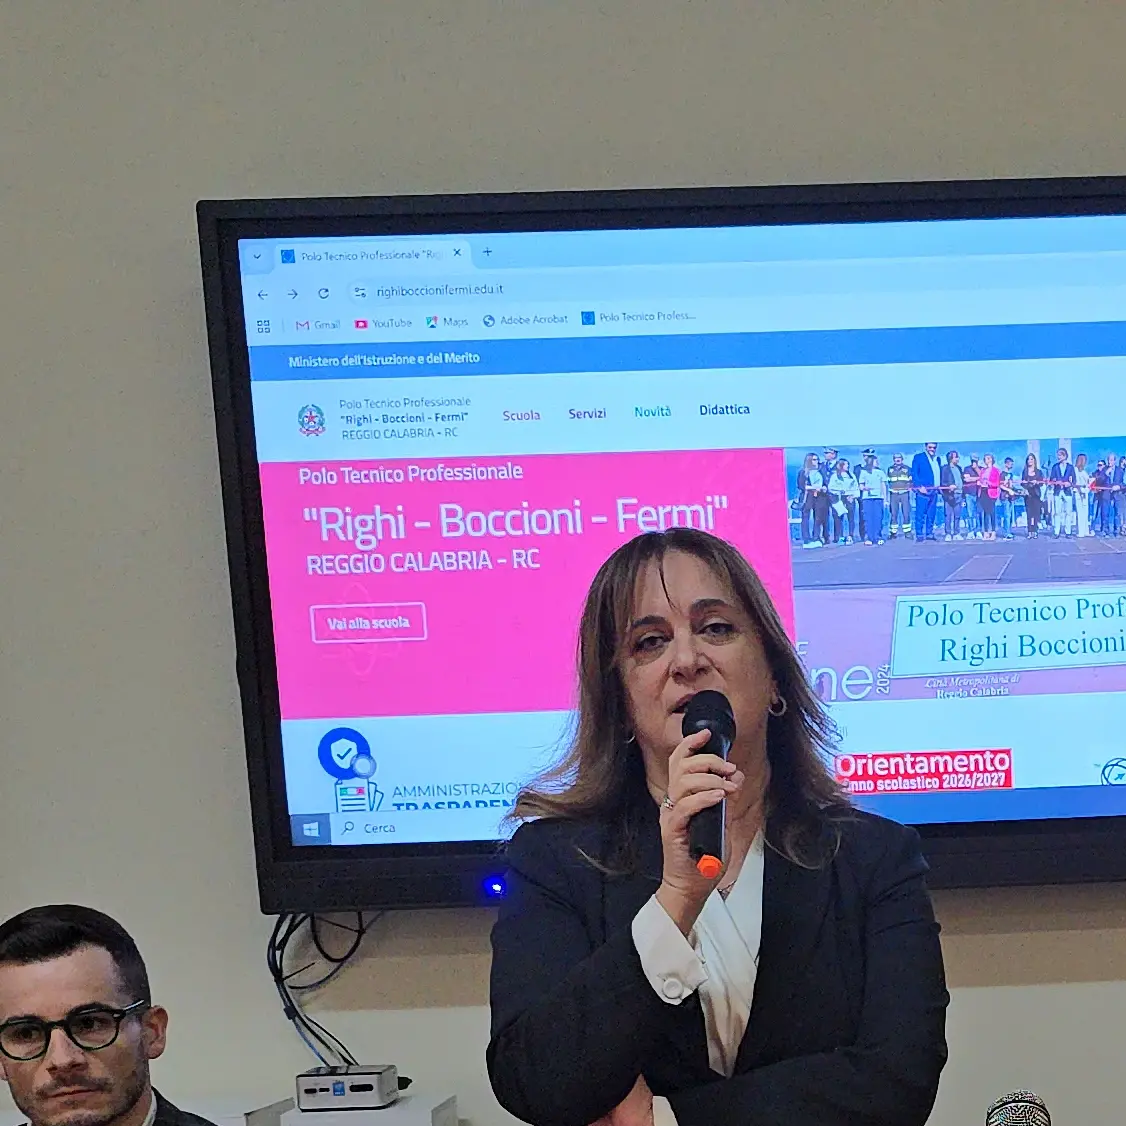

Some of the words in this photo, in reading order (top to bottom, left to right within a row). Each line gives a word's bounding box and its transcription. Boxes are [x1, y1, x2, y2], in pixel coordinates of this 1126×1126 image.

[302, 252, 322, 262] Polo
[325, 252, 358, 261] Tecnico
[361, 250, 420, 261] Professionale
[377, 283, 504, 299] righiboccionifermi.edu.it
[372, 319, 412, 329] YouTube
[444, 318, 469, 328] Maps
[501, 316, 530, 325] Adobe
[533, 315, 568, 324] Acrobat
[600, 314, 620, 323] Polo
[622, 312, 655, 322] Tecnico
[314, 320, 341, 330] Gmail
[289, 356, 340, 368] Ministero
[342, 353, 417, 367] dell'Istruzione
[426, 352, 443, 364] del
[445, 352, 481, 364] Merito
[340, 400, 362, 409] Polo
[364, 398, 401, 409] Tecnico
[404, 396, 471, 408] Professionale
[700, 402, 751, 417] Didattica
[382, 412, 425, 424] Boccioni
[503, 408, 541, 422] Scuola
[568, 406, 607, 420] Servizi
[635, 404, 672, 418] Novità
[342, 430, 381, 440] REGGIO
[384, 428, 435, 439] CALABRIA
[445, 427, 459, 437] RC
[300, 466, 337, 485] Polo
[341, 465, 403, 484] Tecnico
[408, 462, 523, 483] Professionale
[304, 504, 406, 550] "Righi
[440, 499, 582, 539] Boccioni
[616, 495, 728, 533] Fermi"
[307, 554, 385, 575] REGGIO
[390, 551, 493, 573] CALABRIA
[513, 548, 540, 569] RC
[908, 604, 964, 628] Polo
[972, 600, 1067, 625] Tecnico
[328, 617, 346, 630] Vai
[348, 616, 368, 630] alla
[372, 614, 410, 629] scuola
[940, 633, 1008, 667] Righi
[1018, 629, 1126, 659] Boccioni
[876, 663, 891, 694] 2024
[970, 686, 1010, 697] Calabria
[836, 750, 1010, 777] Orientamento
[877, 775, 940, 791] scolastico
[943, 772, 1006, 790] 2026/2027
[364, 822, 396, 834] Cerca
